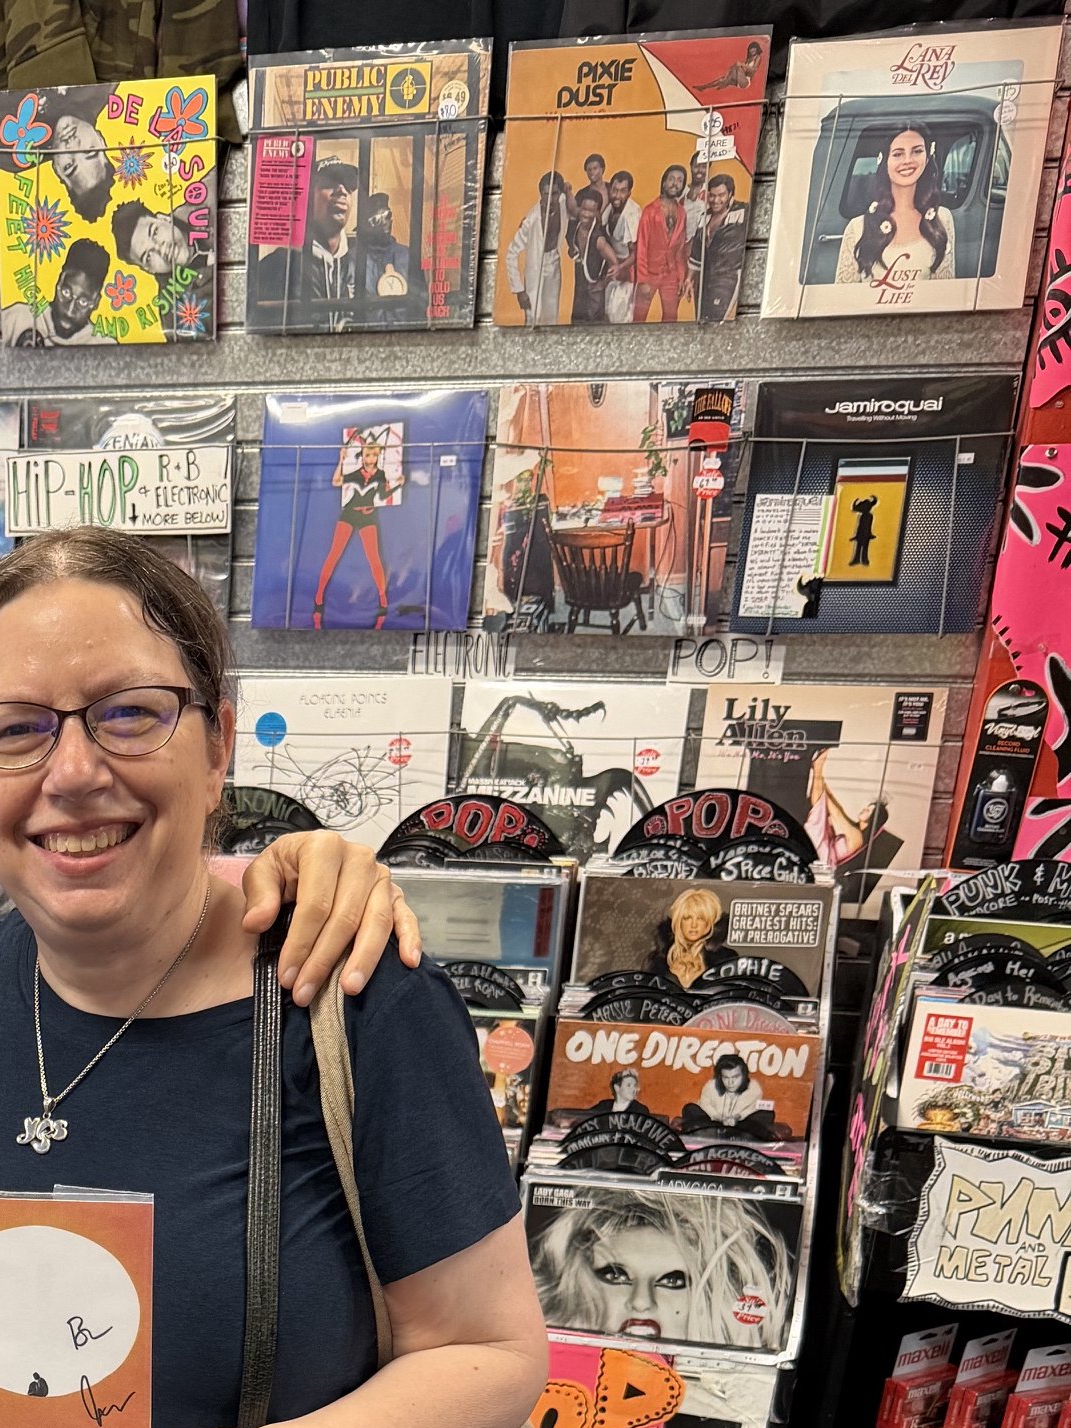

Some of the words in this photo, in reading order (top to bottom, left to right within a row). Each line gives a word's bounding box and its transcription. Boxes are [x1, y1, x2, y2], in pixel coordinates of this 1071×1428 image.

[890, 43, 957, 72] LANA
[306, 66, 385, 91] PUBLIC
[577, 58, 637, 84] PIXIE
[914, 61, 956, 90] REY
[306, 95, 384, 120] ENEMY
[557, 83, 619, 108] DUST
[108, 94, 143, 126] DE
[179, 155, 212, 246] SOUL
[870, 253, 922, 290] LUST
[876, 288, 914, 305] LIFE
[92, 315, 130, 338] AND
[825, 397, 944, 415] Jamiroquai
[141, 512, 179, 527] MORE
[183, 509, 225, 526] BELOW
[722, 697, 792, 728] Lily
[715, 721, 807, 751] Allen
[984, 745, 1014, 753] CLEANING
[420, 800, 527, 848] POP
[665, 791, 775, 840] POP
[942, 862, 1022, 917] PUNK
[1033, 863, 1045, 886] &
[732, 916, 785, 931] GREATEST
[786, 917, 818, 932] HITS:
[733, 903, 777, 918] BRITNEY
[778, 904, 820, 919] SPEARS
[730, 928, 747, 944] MY
[747, 929, 818, 946] PREROGATIVE
[639, 999, 684, 1026] PETERS
[565, 1029, 639, 1065] ONE
[642, 1028, 810, 1079] DIRECTION
[608, 1113, 676, 1149] MCALPINE
[533, 1186, 555, 1198] LADY
[555, 1188, 575, 1199] GAGA
[555, 1197, 573, 1208] THIS
[572, 1199, 592, 1209] WAY
[1016, 1241, 1047, 1255] AND
[934, 1244, 1053, 1288] METAL
[896, 1341, 951, 1368] maxell
[959, 1344, 1010, 1373] maxell
